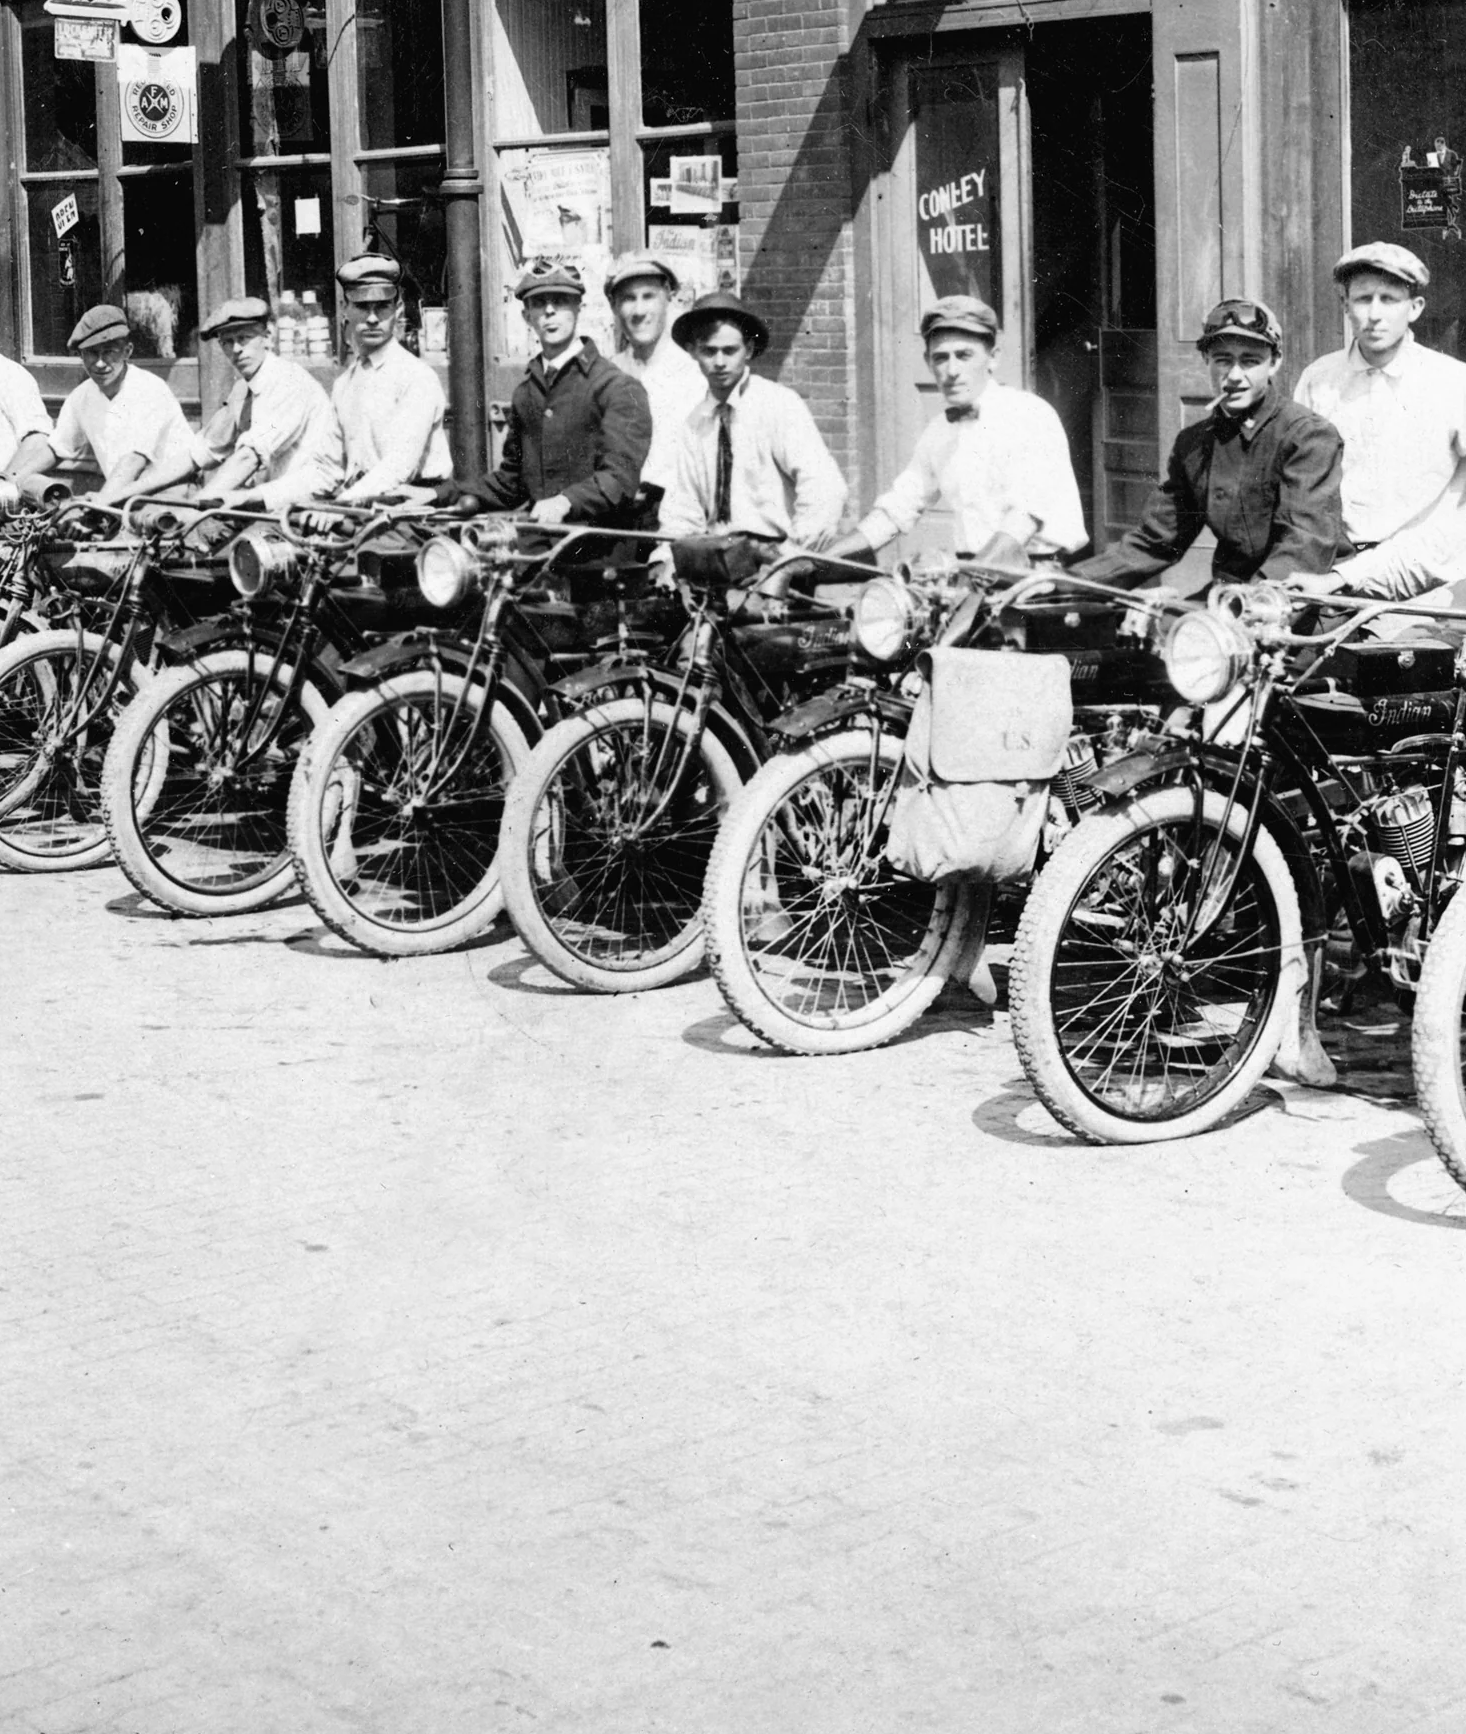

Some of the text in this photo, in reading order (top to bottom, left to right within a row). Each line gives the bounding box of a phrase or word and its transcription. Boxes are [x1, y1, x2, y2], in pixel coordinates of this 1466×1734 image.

[132, 105, 178, 131] REPAIR SHOP
[918, 168, 987, 221] CONLEY
[929, 224, 990, 255] HOTEL
[1368, 698, 1432, 727] Indian
